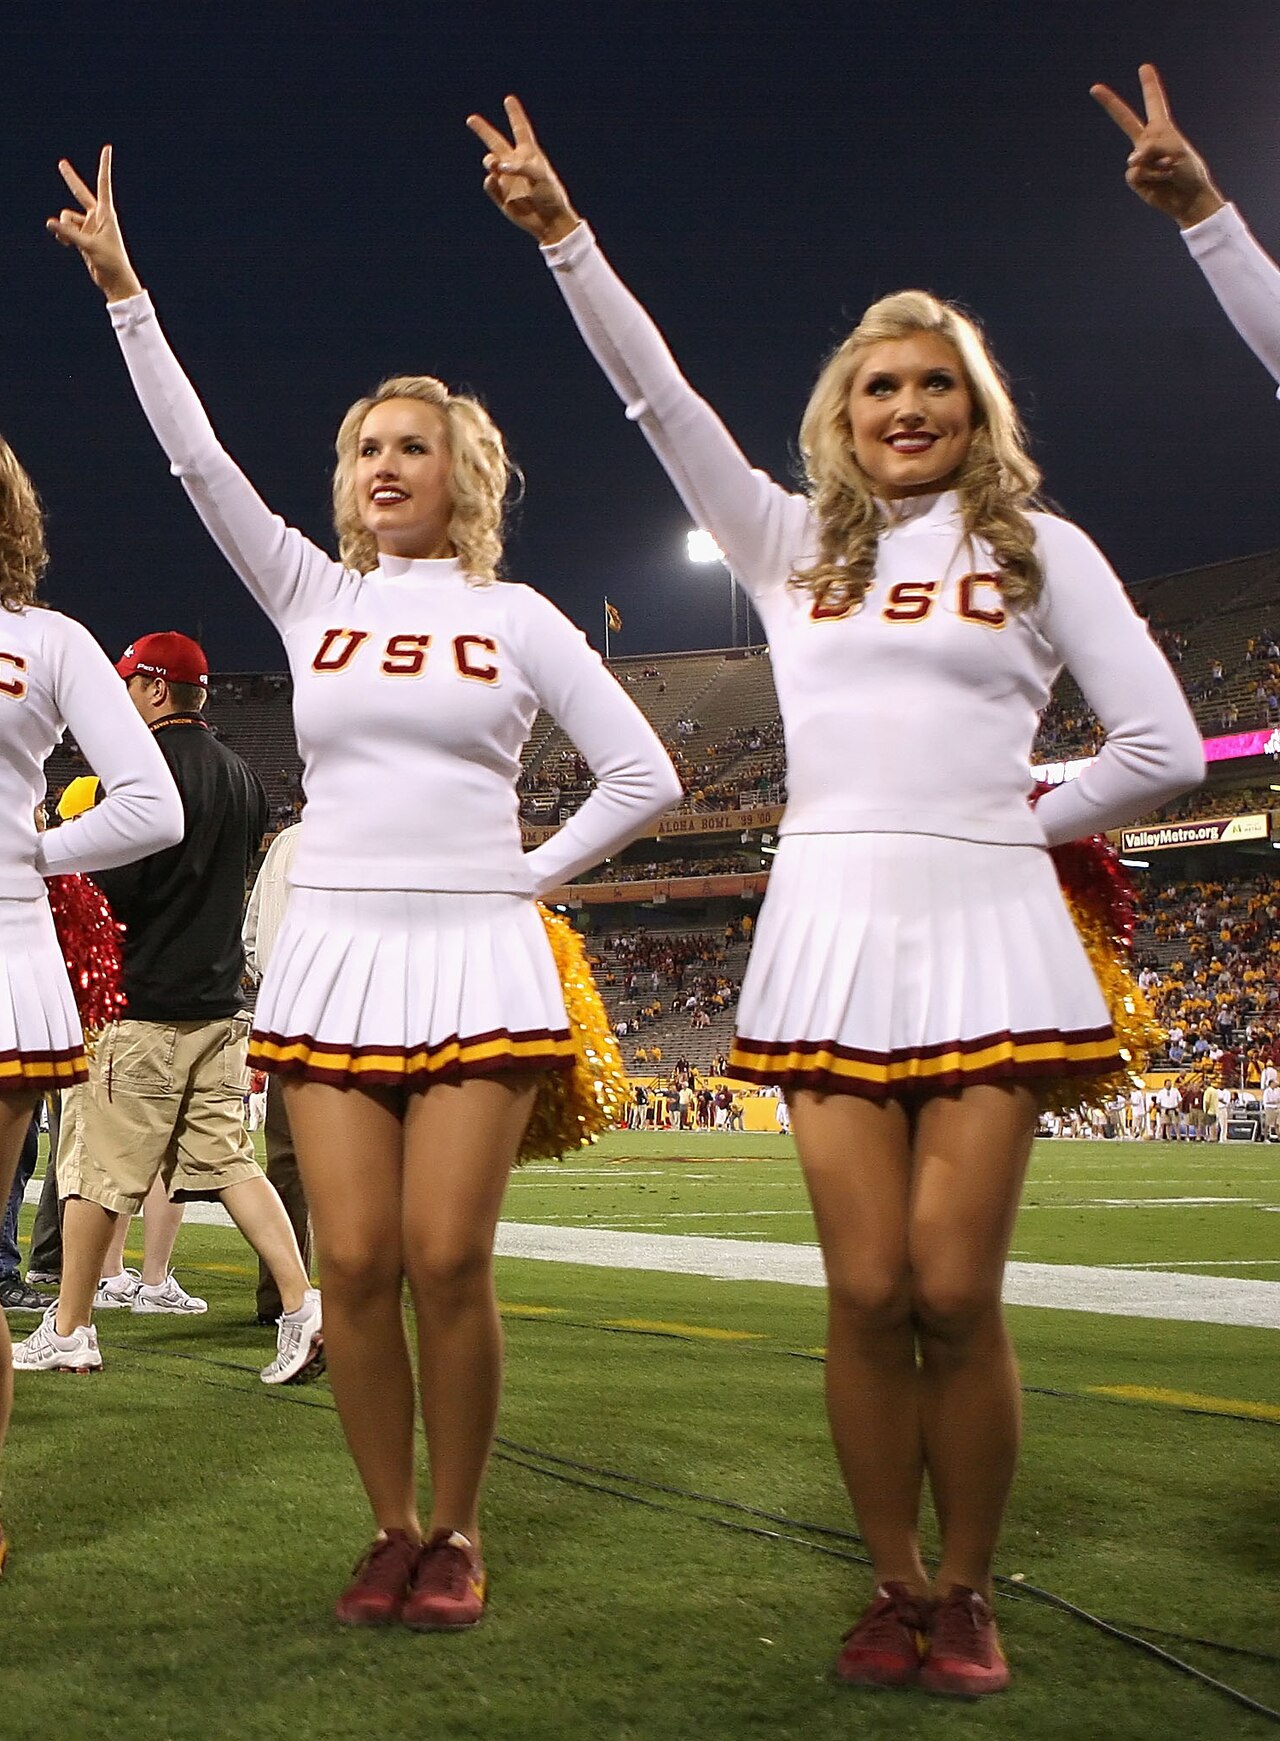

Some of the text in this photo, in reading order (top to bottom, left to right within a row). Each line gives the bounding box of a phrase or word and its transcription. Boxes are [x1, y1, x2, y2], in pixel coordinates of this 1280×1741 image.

[310, 627, 499, 684] USC
[658, 820, 695, 833] ALOHA
[701, 816, 733, 830] BOWL
[1124, 826, 1220, 848] ValleyMetro.org
